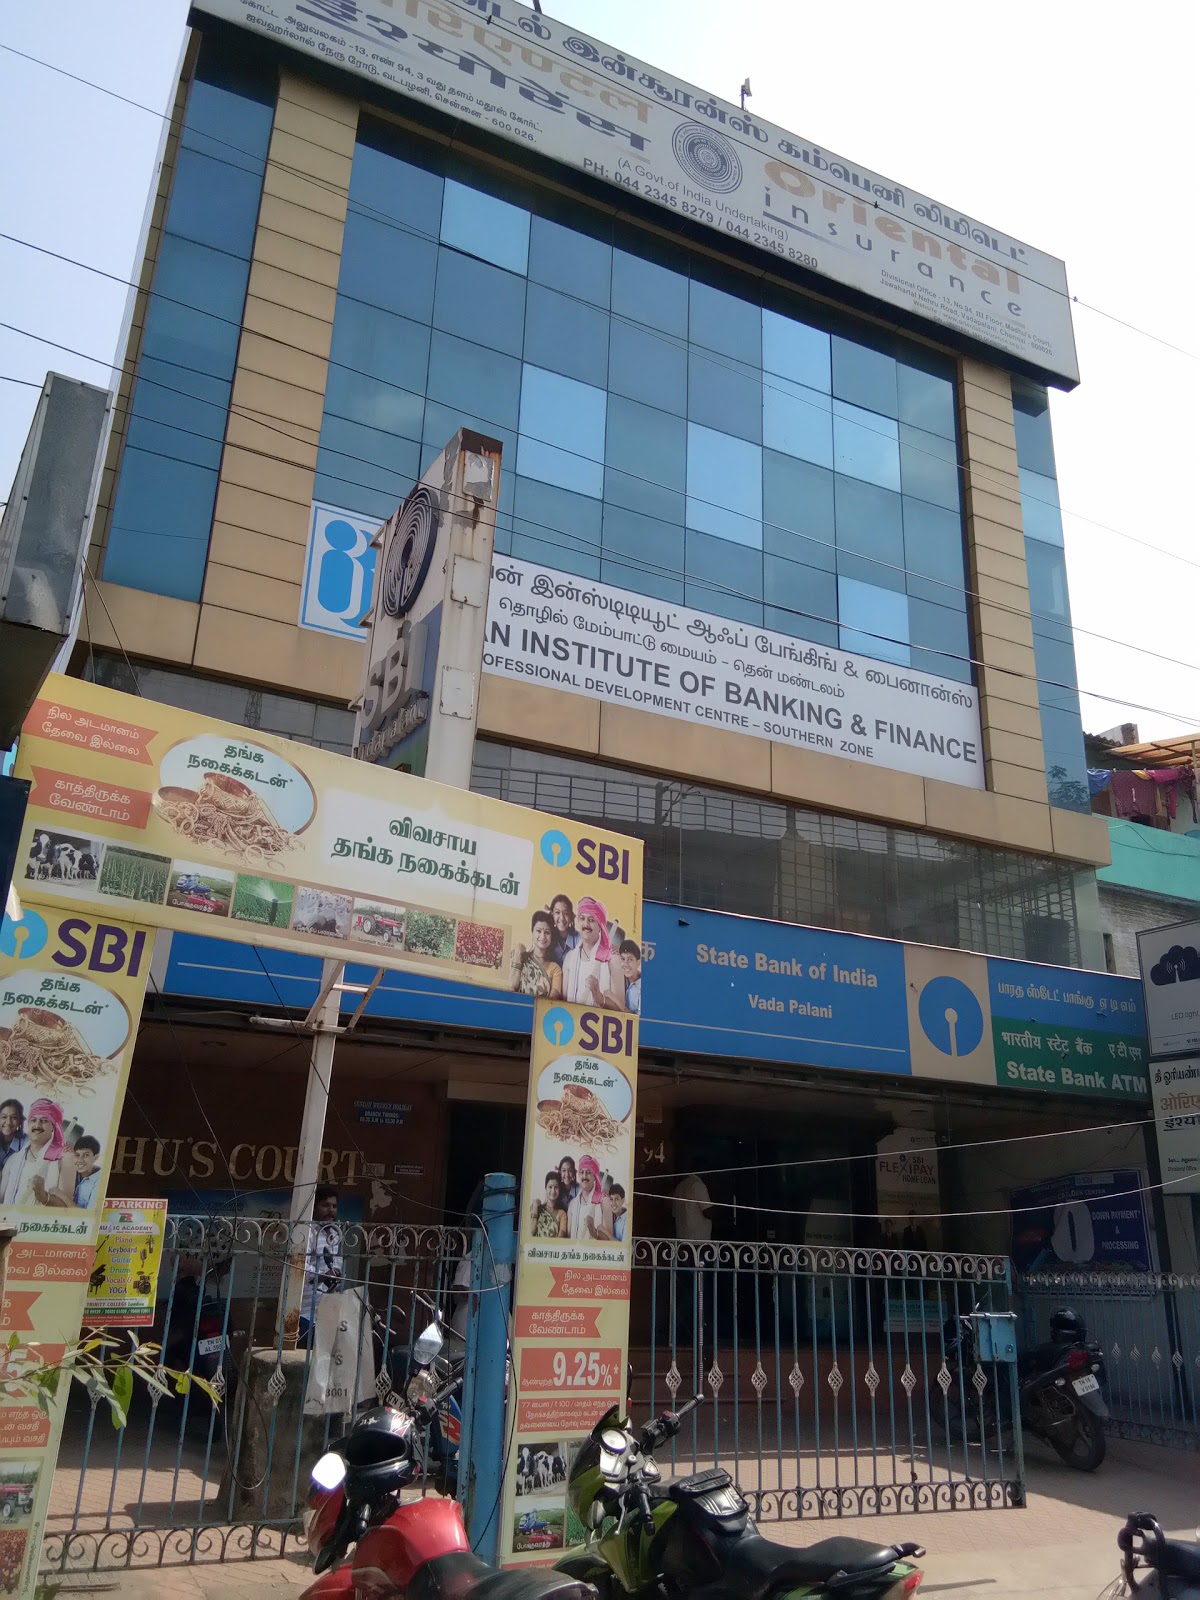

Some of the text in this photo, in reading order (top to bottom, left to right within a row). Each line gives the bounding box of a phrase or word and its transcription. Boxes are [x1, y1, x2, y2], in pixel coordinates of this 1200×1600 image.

[246, 13, 316, 48] ஜவஹர்லால்
[318, 42, 346, 62] நேரு
[434, 92, 482, 119] சென்னை
[491, 118, 512, 131] 600
[284, 13, 346, 47] அலுவலகம்
[371, 53, 396, 68] எண்
[417, 71, 424, 80] 3
[426, 76, 447, 92] வது
[448, 85, 474, 103] தளம்
[582, 157, 818, 268] PH: 044 2345 8279 044 2345 8280
[683, 184, 711, 206] India
[715, 196, 789, 242] Undertaking)
[778, 134, 905, 209] கம்பெனி
[914, 203, 1029, 266] லிமிடெட்
[763, 159, 1021, 295] Oriental
[764, 184, 1023, 317] insurance
[880, 279, 917, 299] Jawaharlal
[917, 292, 939, 308] Nehru
[881, 269, 916, 290] Divisional
[916, 284, 937, 299] Office
[498, 596, 845, 698] தொழில் மேம்பாட்டு மையம் தென் மண்டலம்
[361, 620, 428, 729] SBI
[686, 617, 749, 648] ஆஃப்
[755, 632, 837, 673] பேங்கிங்
[842, 659, 859, 679] &
[865, 669, 973, 709] பைனான்ஸ்
[483, 652, 874, 759] OFESSIONAL DEVELOPMENT CENTRE SOUTHERN ZONE
[521, 628, 977, 764] INSTITUTE OF BANKING & FINANCE
[46, 705, 140, 740] நில அடமானம்
[41, 721, 140, 757] தேவை இல்லை
[223, 743, 265, 764] தங்க
[54, 777, 131, 806] காத்திருக்க
[49, 793, 131, 821] வேண்டாம்
[389, 815, 478, 856] விவசாய
[331, 836, 521, 897] தங்க நகைக்கடன்
[575, 838, 630, 885] SBI
[51, 918, 147, 978] SBI
[696, 943, 878, 988] State Bank of India
[39, 976, 81, 993] தங்க
[998, 982, 1024, 999] பாரத
[748, 993, 833, 1019] Vada Palani
[578, 1011, 634, 1057] SBI
[1001, 1030, 1093, 1056] भारतीय स्टेट बैंक
[574, 1058, 600, 1071] தங்க
[1006, 1060, 1148, 1094] State Bank ATM
[111, 1134, 218, 1178] HU'S
[879, 1159, 935, 1176] FLEXIPAY
[112, 1200, 163, 1209] PARKING
[18, 1219, 88, 1234] நகைக்கடன்
[16, 1248, 88, 1260] அடமானம்
[108, 1246, 137, 1254] Keyboard
[527, 1247, 625, 1262] விவசாய தங்க நகைக்கடன்
[1101, 1240, 1140, 1250] PROCESSING
[32, 1262, 88, 1278] இல்லை
[564, 1269, 628, 1282] நில அடமானம்
[109, 1286, 127, 1294] YOGA
[561, 1283, 629, 1297] தேவை இல்லை
[528, 1323, 586, 1335] வேண்டாம்
[531, 1309, 585, 1323] காத்திருக்க
